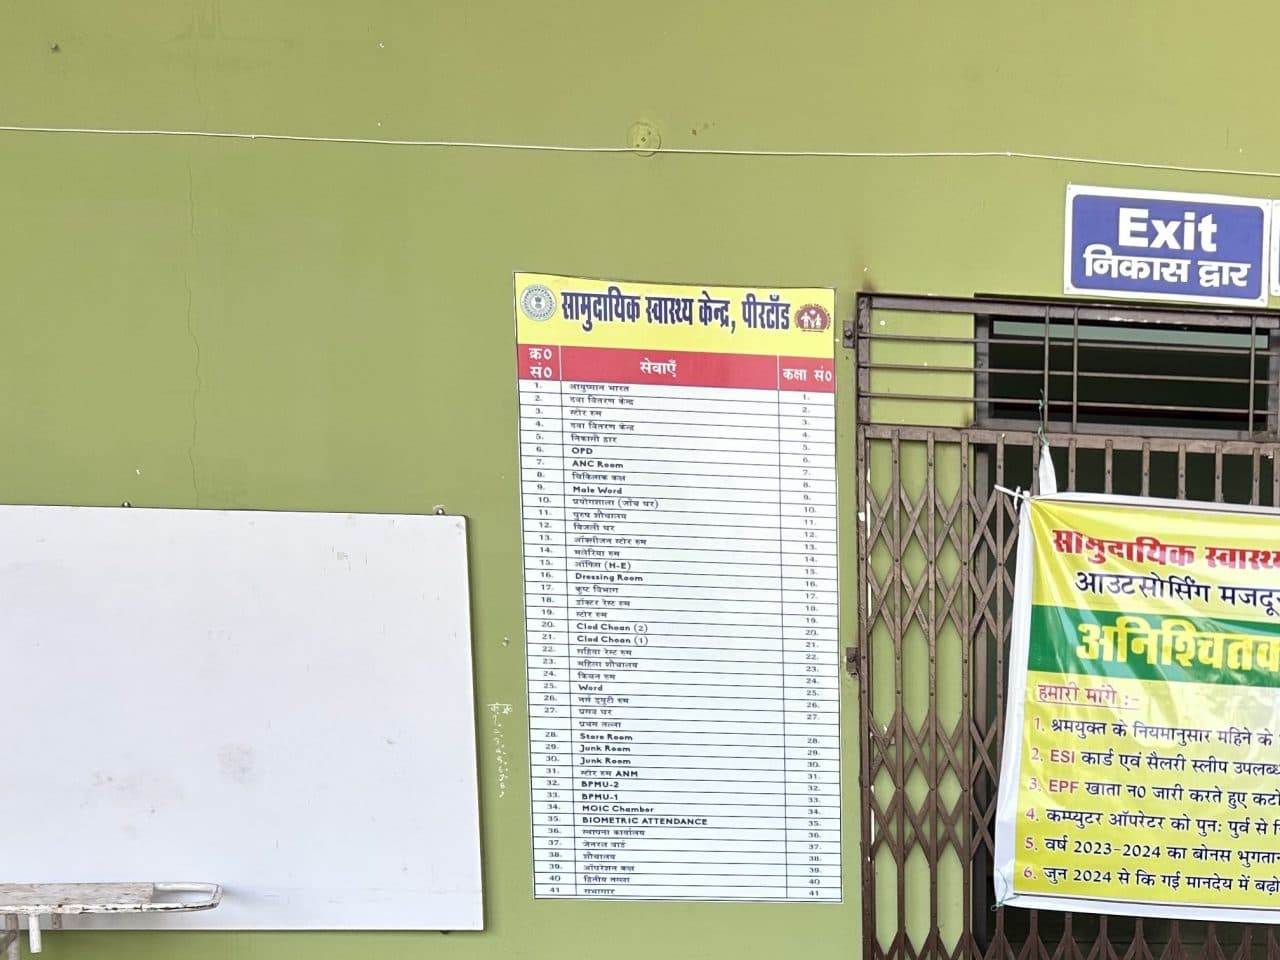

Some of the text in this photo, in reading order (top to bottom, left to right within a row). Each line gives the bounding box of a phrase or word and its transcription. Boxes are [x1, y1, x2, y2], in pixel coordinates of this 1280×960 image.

[1119, 208, 1218, 252] Exit
[1083, 244, 1251, 288] निकास द्वार
[561, 287, 640, 331] सामुदायिक
[646, 299, 694, 325] स्वास्थ्य
[698, 290, 736, 334] केन्द्र,
[782, 367, 807, 382] कक्षा
[572, 447, 593, 455] OPD
[572, 460, 624, 469] ANC Room
[1052, 529, 1197, 565] सामुदायिक
[575, 573, 644, 582] Dressing Room
[1075, 571, 1211, 603] आउटसोर्सिंग
[633, 623, 649, 634] (2)
[633, 635, 649, 646] (1)
[1037, 683, 1079, 702] हमारी
[607, 733, 633, 742] Room
[1051, 718, 1106, 740] श्रमयुक्त
[1112, 720, 1127, 737] के
[1133, 721, 1211, 745] नियमानुसार
[1218, 727, 1252, 745] महिने
[1257, 728, 1273, 746] के
[579, 744, 631, 753] Junk Room
[579, 757, 631, 765] Junk Room
[1050, 749, 1075, 763] ESI
[1081, 749, 1114, 766] कार्ड
[1119, 751, 1142, 772] एवं
[1147, 751, 1185, 771] सैलरी
[1192, 754, 1227, 773] स्लीप
[581, 780, 620, 788] BPMU-2
[582, 793, 619, 801] BPMU-1
[1048, 779, 1078, 794] EPF
[1085, 780, 1121, 796] खाता
[1152, 783, 1183, 800] जारी
[1189, 786, 1222, 803] करते
[1228, 792, 1247, 809] हुए
[582, 805, 610, 813] MOIC
[582, 816, 708, 826] BIOMETRIC ATTENDANCE
[1047, 808, 1102, 830] कम्प्युटर
[1110, 810, 1165, 829] ऑपरेटर
[1171, 812, 1190, 830] को
[1228, 817, 1249, 838] पुर्व
[1256, 817, 1268, 835] से
[1044, 834, 1067, 852] वर्ष
[1073, 840, 1161, 858] 2023-2024
[1167, 845, 1186, 859] का
[1192, 844, 1231, 862] बोनस
[1043, 867, 1067, 884] जुन
[1073, 869, 1111, 883] 2024
[1117, 868, 1129, 884] से
[1135, 869, 1155, 886] कि
[1162, 873, 1180, 890] गई
[1186, 875, 1232, 891] मानदेय
[1240, 874, 1249, 890] में
